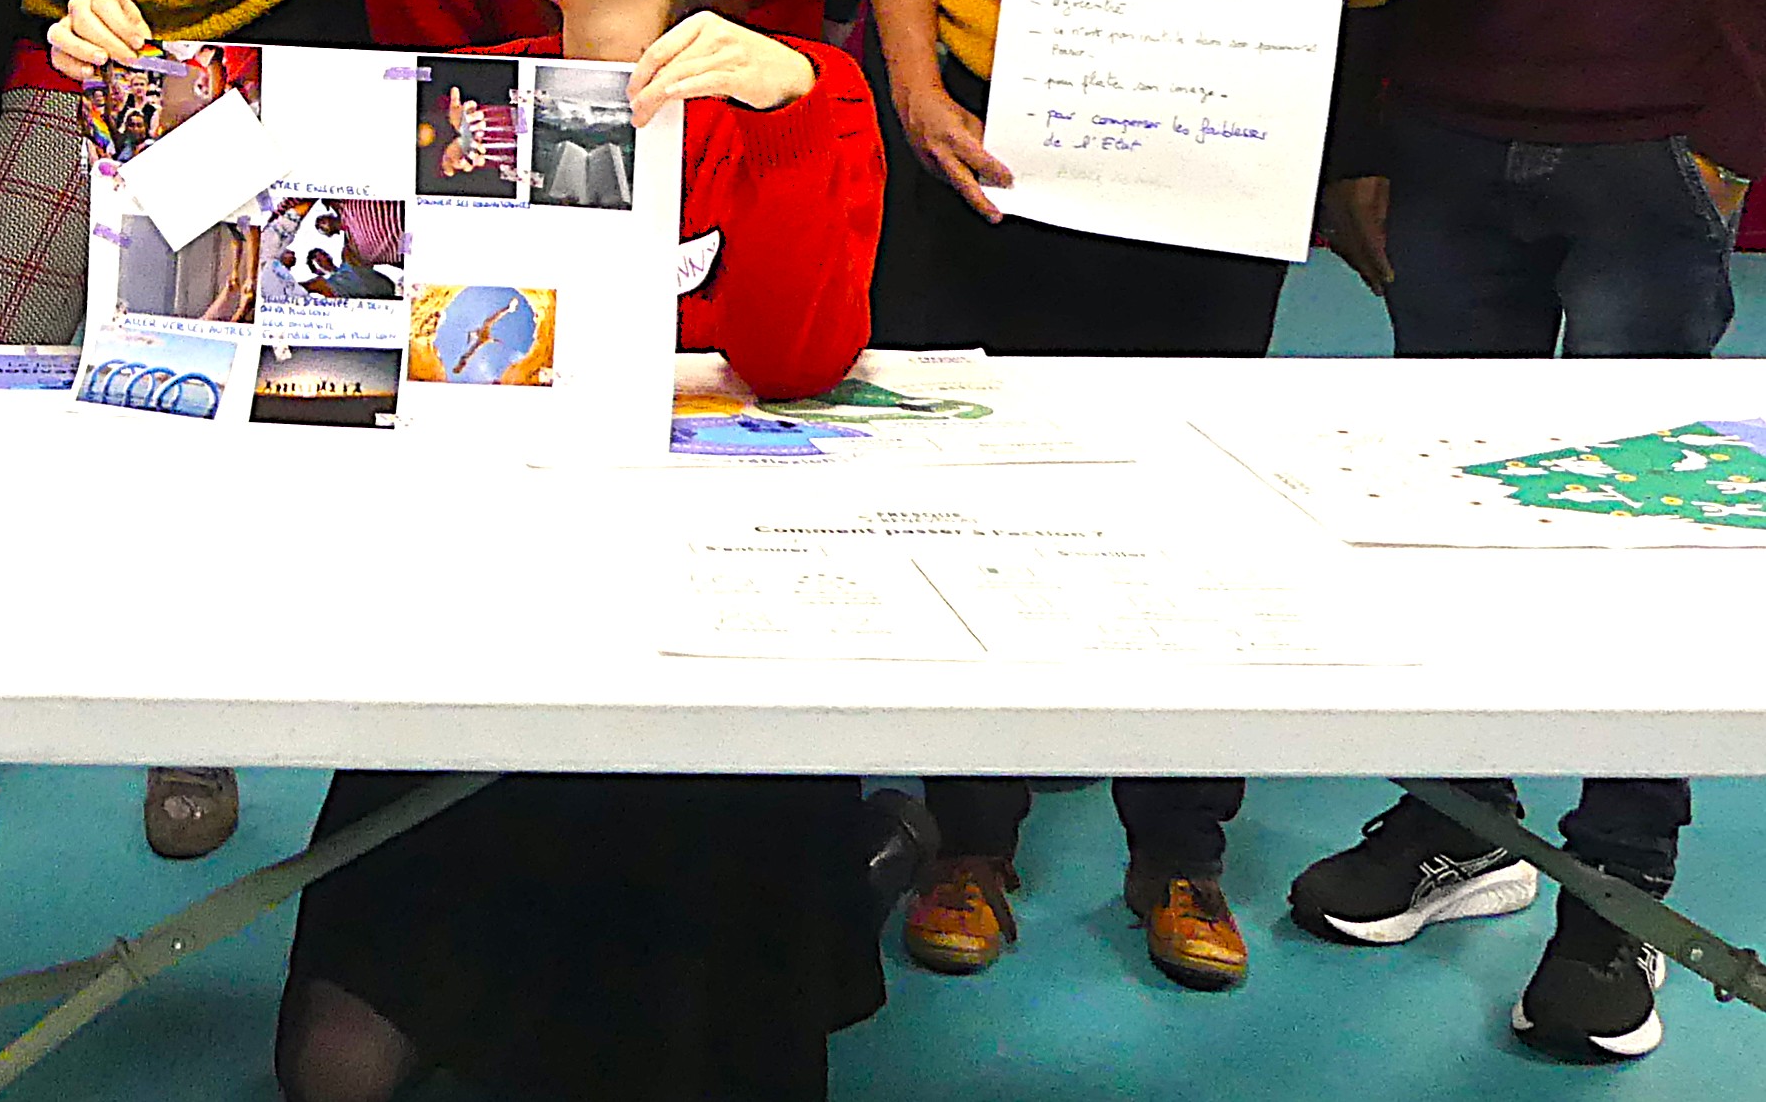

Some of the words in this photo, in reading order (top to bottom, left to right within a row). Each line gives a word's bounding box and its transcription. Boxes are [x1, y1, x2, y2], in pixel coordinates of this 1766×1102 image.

[1042, 131, 1063, 148] de
[753, 525, 877, 535] Comment
[885, 528, 962, 536] passer
